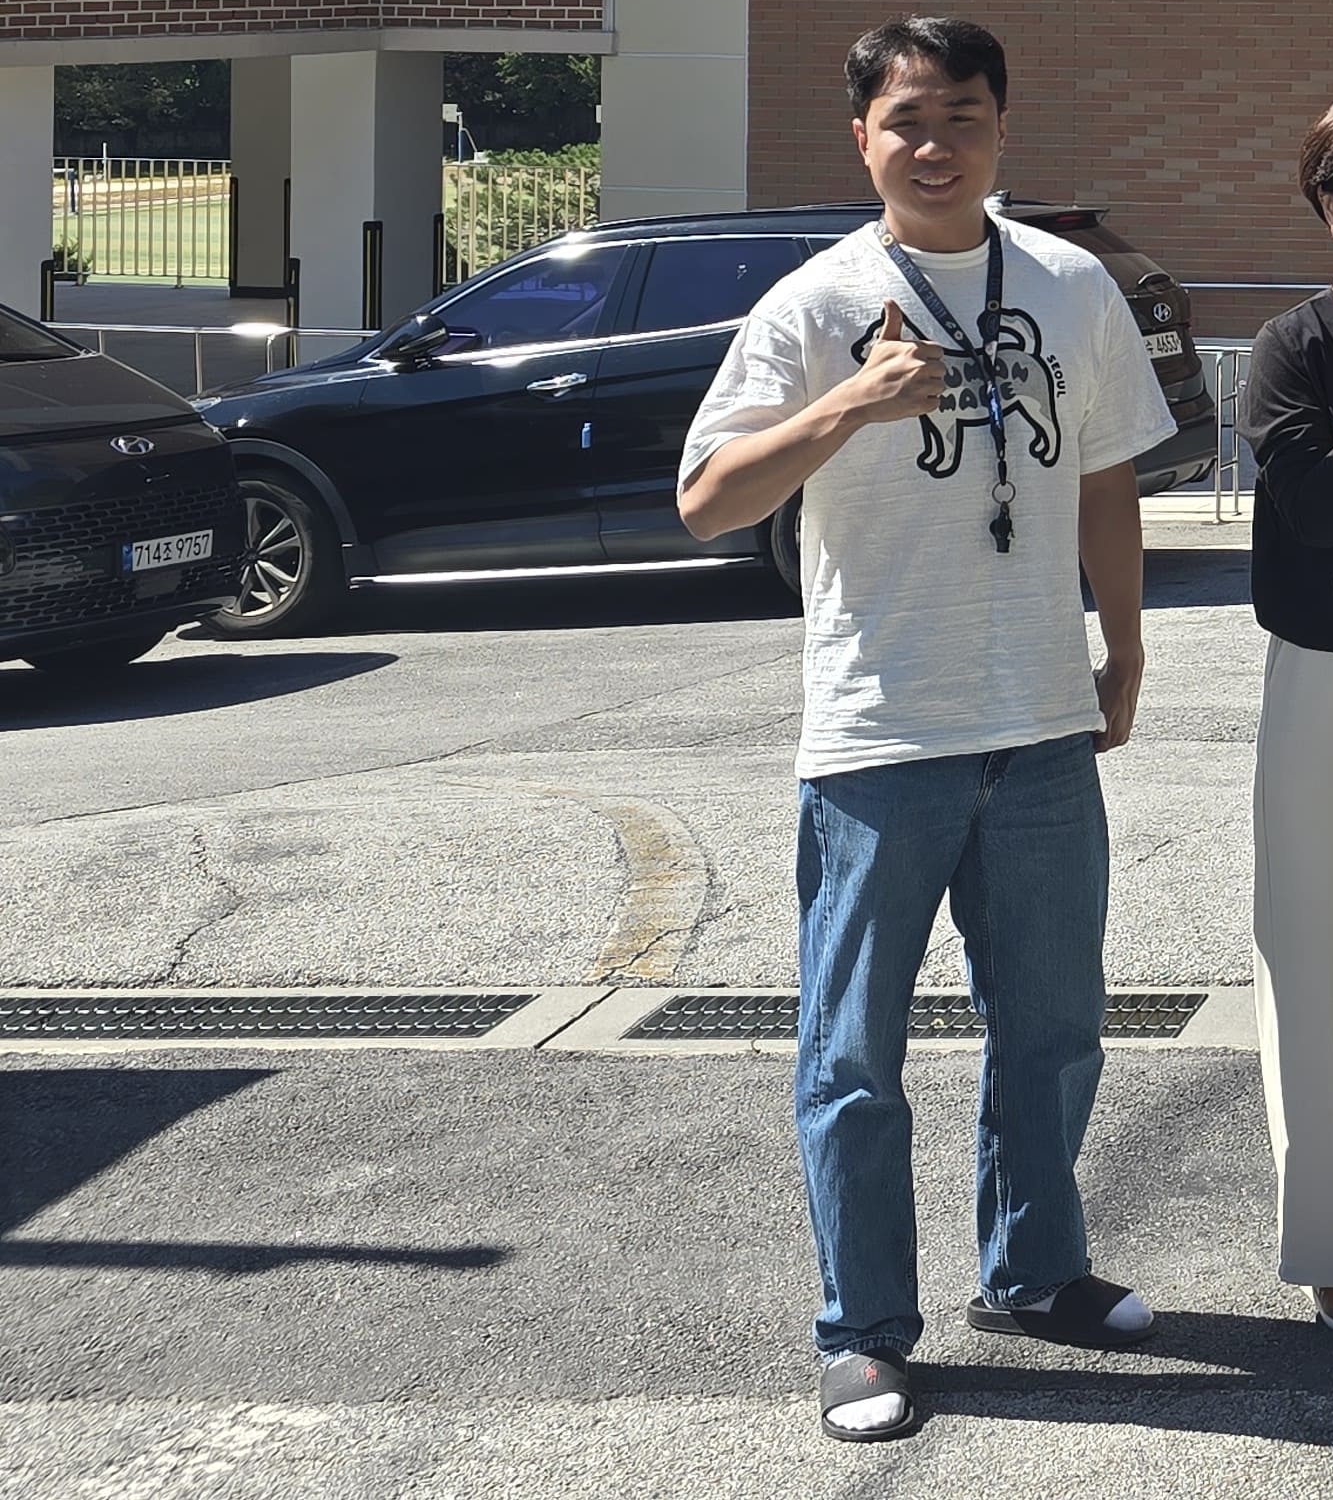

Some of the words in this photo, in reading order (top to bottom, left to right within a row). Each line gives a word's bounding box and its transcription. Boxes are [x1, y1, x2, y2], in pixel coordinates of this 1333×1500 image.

[944, 357, 1028, 388] UMAN
[1046, 354, 1066, 398] SEOUL
[134, 542, 172, 567] 714조
[176, 533, 210, 559] 9757
